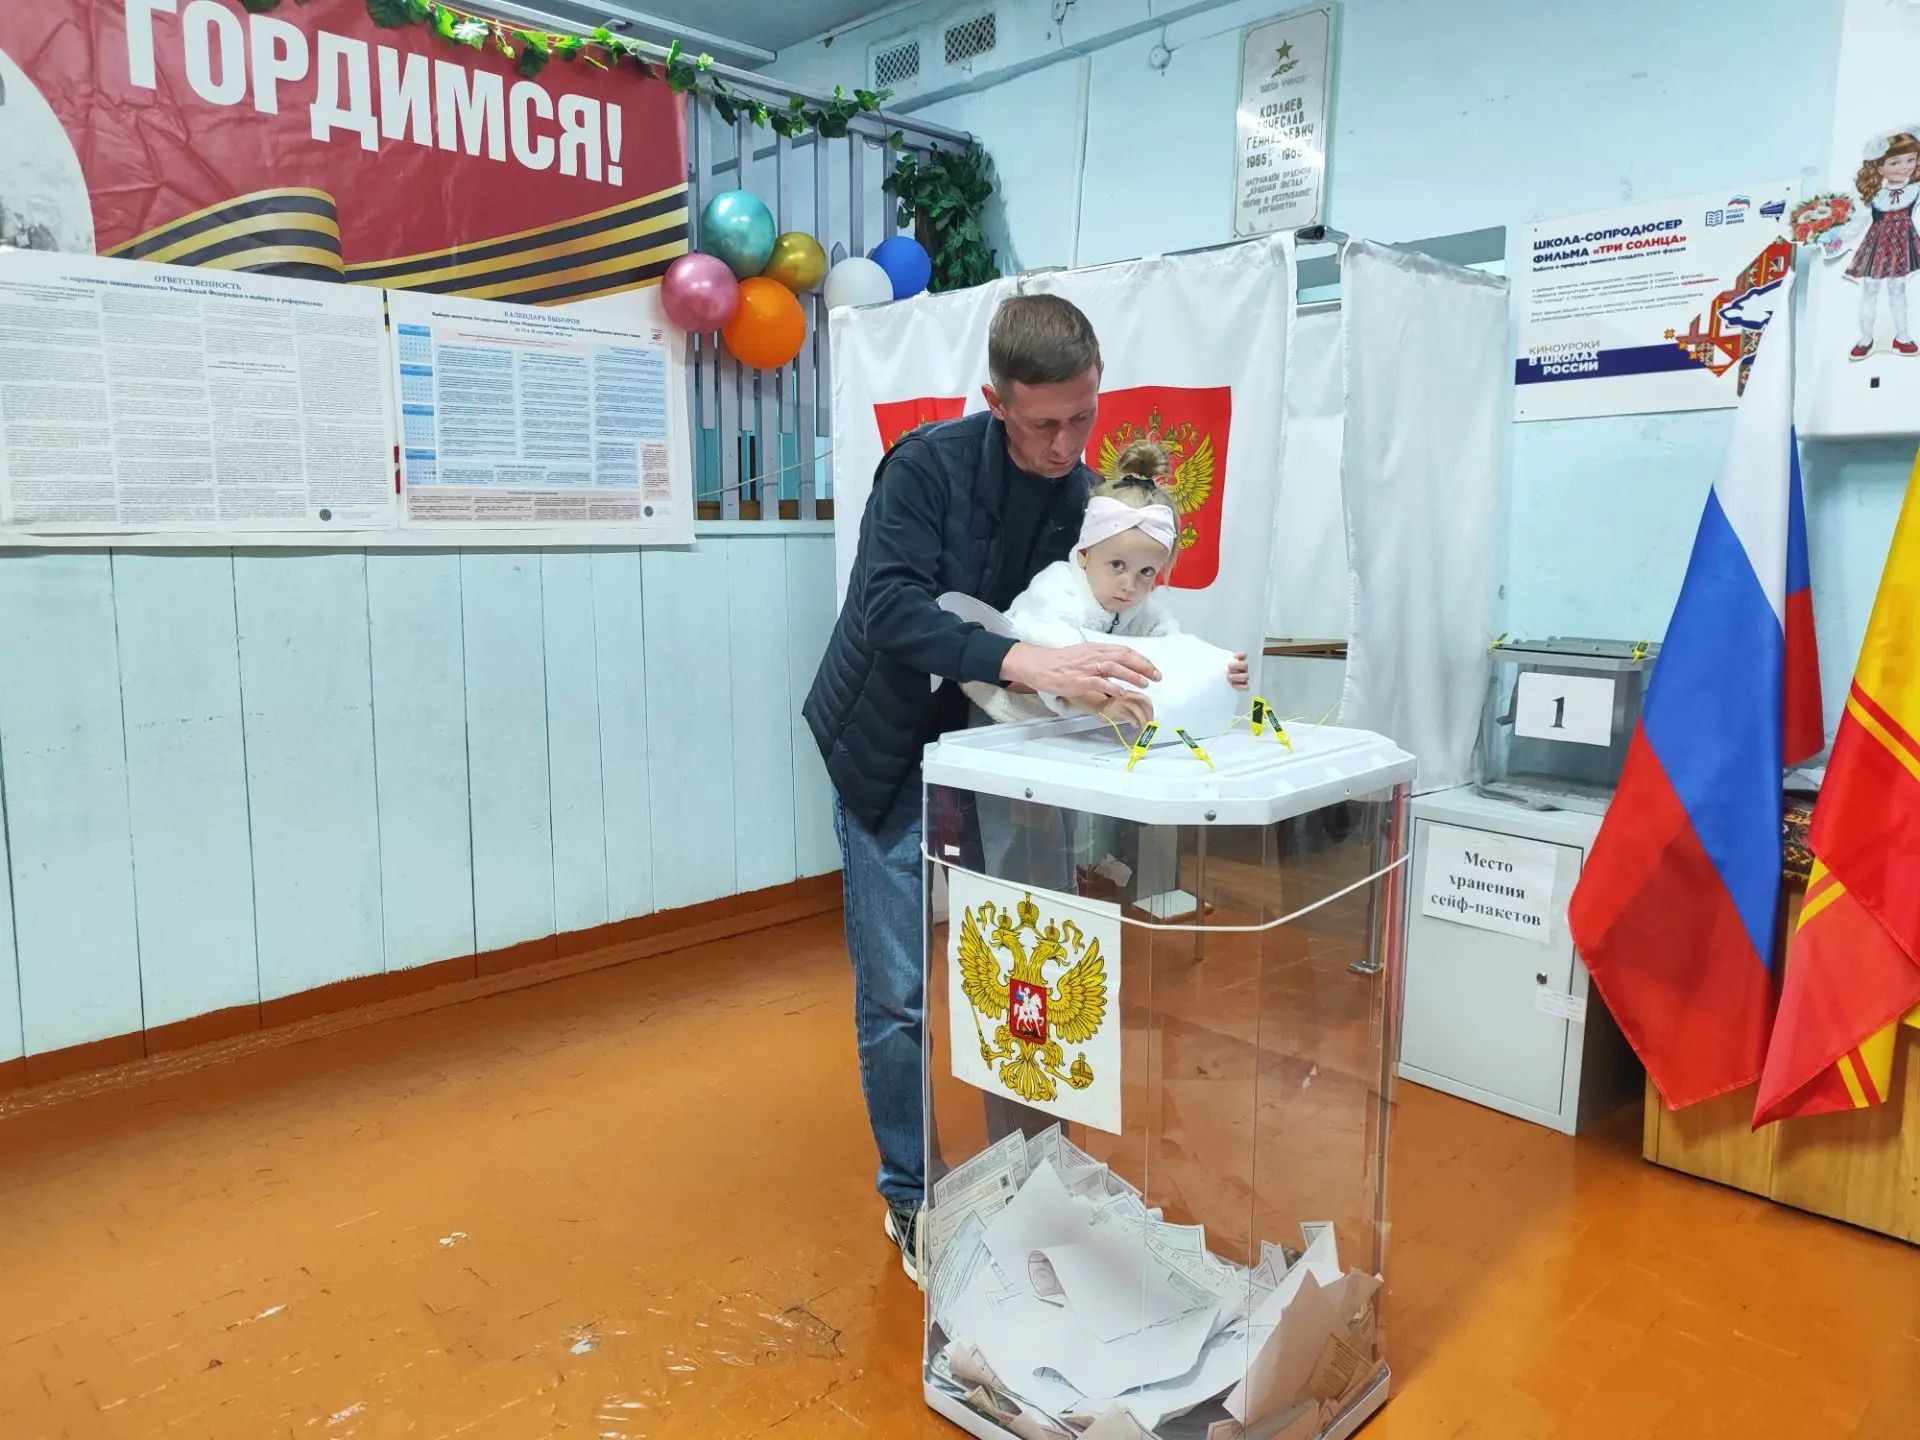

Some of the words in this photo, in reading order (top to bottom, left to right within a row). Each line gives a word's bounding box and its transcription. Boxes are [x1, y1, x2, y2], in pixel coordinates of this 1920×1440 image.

[124, 0, 623, 186] ГОРДИМСЯ!
[1533, 219, 1683, 250] ШКОЛА-СОПРОДЮСЕР
[1533, 248, 1589, 264] ФИЛЬМА
[1593, 243, 1622, 255] «ТРИ
[1626, 234, 1687, 250] СОЛНЦА»
[154, 275, 242, 290] ОТВЕТСТВЕННОСТЬ
[504, 311, 545, 322] КАЛЕНДАРЬ
[547, 314, 580, 325] ВЫБОРОВ
[1528, 340, 1600, 355] КИНОУРОКИ
[1528, 354, 1538, 366] В
[1540, 350, 1599, 365] ШКОЛАХ
[1543, 361, 1599, 375] РОССИИ
[1550, 696, 1565, 729] 1
[1463, 850, 1513, 873] Место
[1448, 874, 1525, 900] хранения
[1431, 893, 1541, 927] сейф-пакетов
